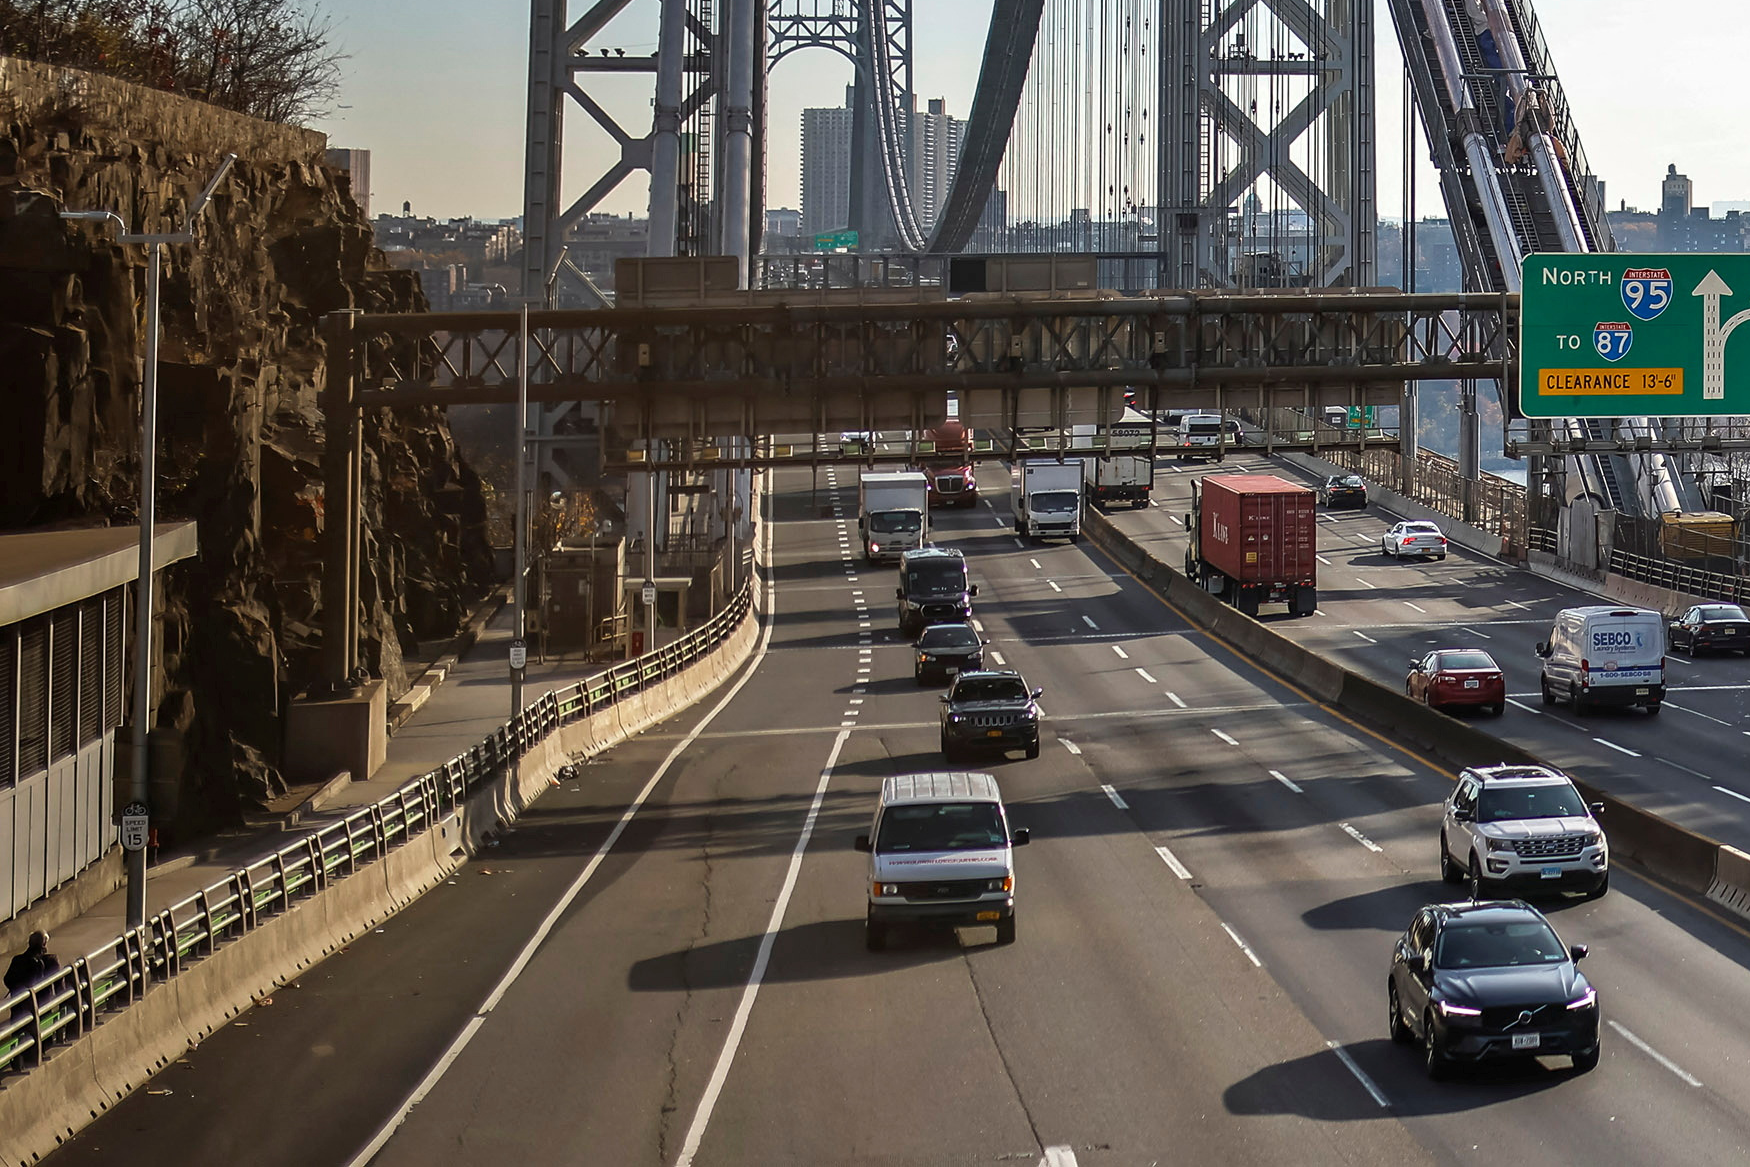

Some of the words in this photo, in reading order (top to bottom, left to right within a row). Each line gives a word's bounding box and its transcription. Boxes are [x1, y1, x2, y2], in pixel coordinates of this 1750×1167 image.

[1542, 267, 1612, 285] NORTH
[1629, 269, 1665, 279] INTERSTATE
[1625, 281, 1668, 310] 95
[1556, 335, 1581, 350] TO
[1597, 332, 1629, 354] 87
[1546, 374, 1631, 389] CLEARANCE
[1593, 632, 1631, 646] SEBCO
[127, 833, 142, 846] 15
